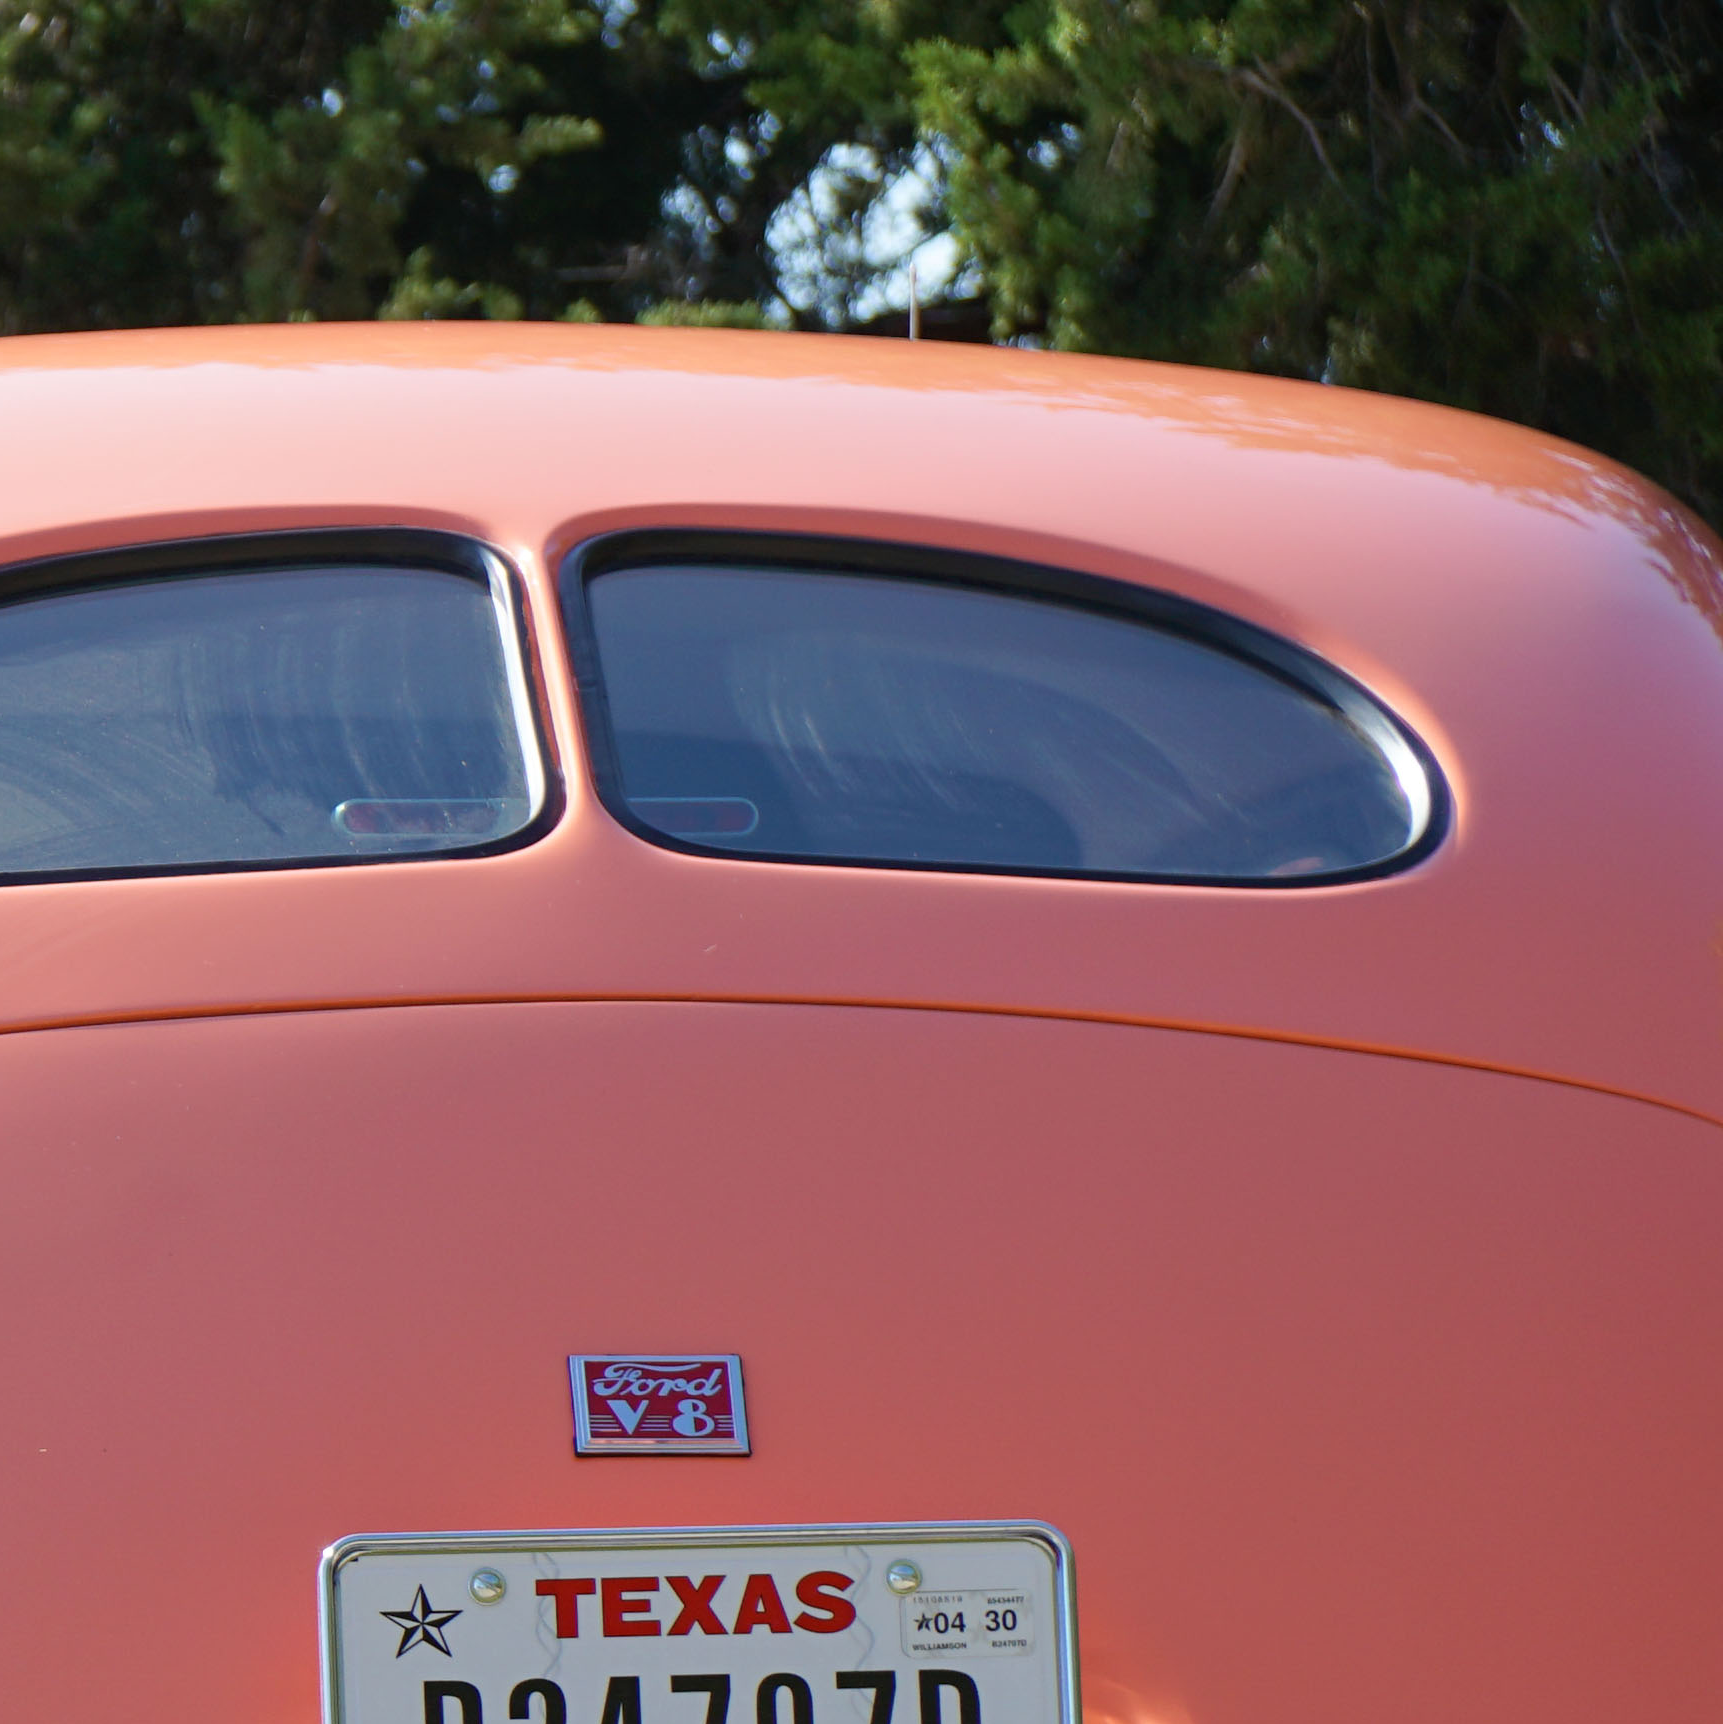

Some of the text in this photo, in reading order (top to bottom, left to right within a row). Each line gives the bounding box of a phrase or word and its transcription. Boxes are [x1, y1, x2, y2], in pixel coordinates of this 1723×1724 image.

[592, 1363, 723, 1396] Ford
[535, 1571, 858, 1639] TEXAS
[934, 1609, 1017, 1634] 04 30
[912, 1642, 967, 1651] WILLIAMSON
